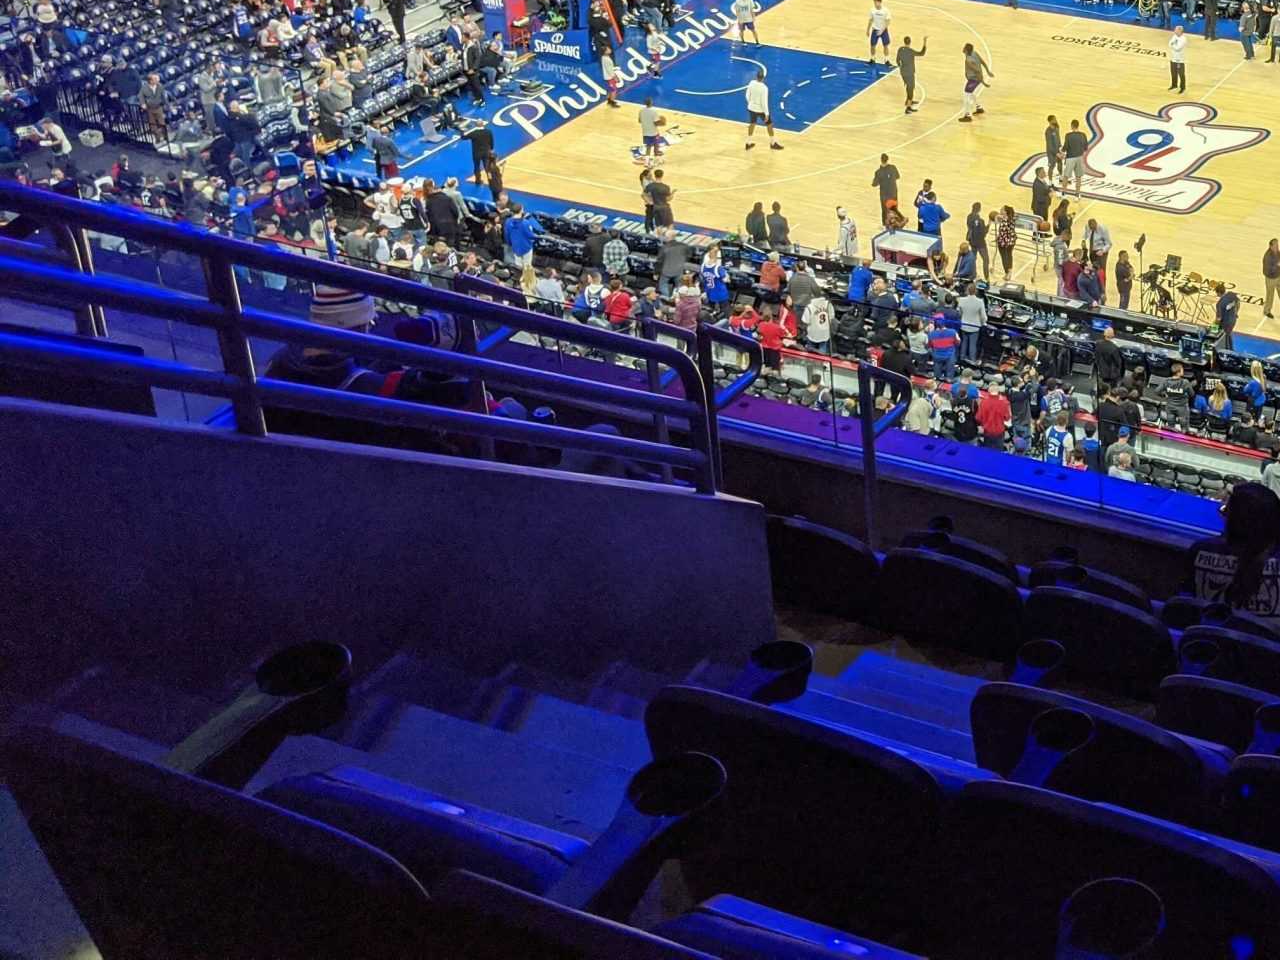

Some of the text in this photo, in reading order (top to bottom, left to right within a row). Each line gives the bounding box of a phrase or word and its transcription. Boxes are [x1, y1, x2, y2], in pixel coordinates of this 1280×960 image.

[534, 39, 581, 60] SPALDING
[1051, 34, 1168, 58] WELLS FARGO
[1112, 128, 1182, 173] 76
[562, 208, 608, 225] USA
[1048, 443, 1059, 457] 21
